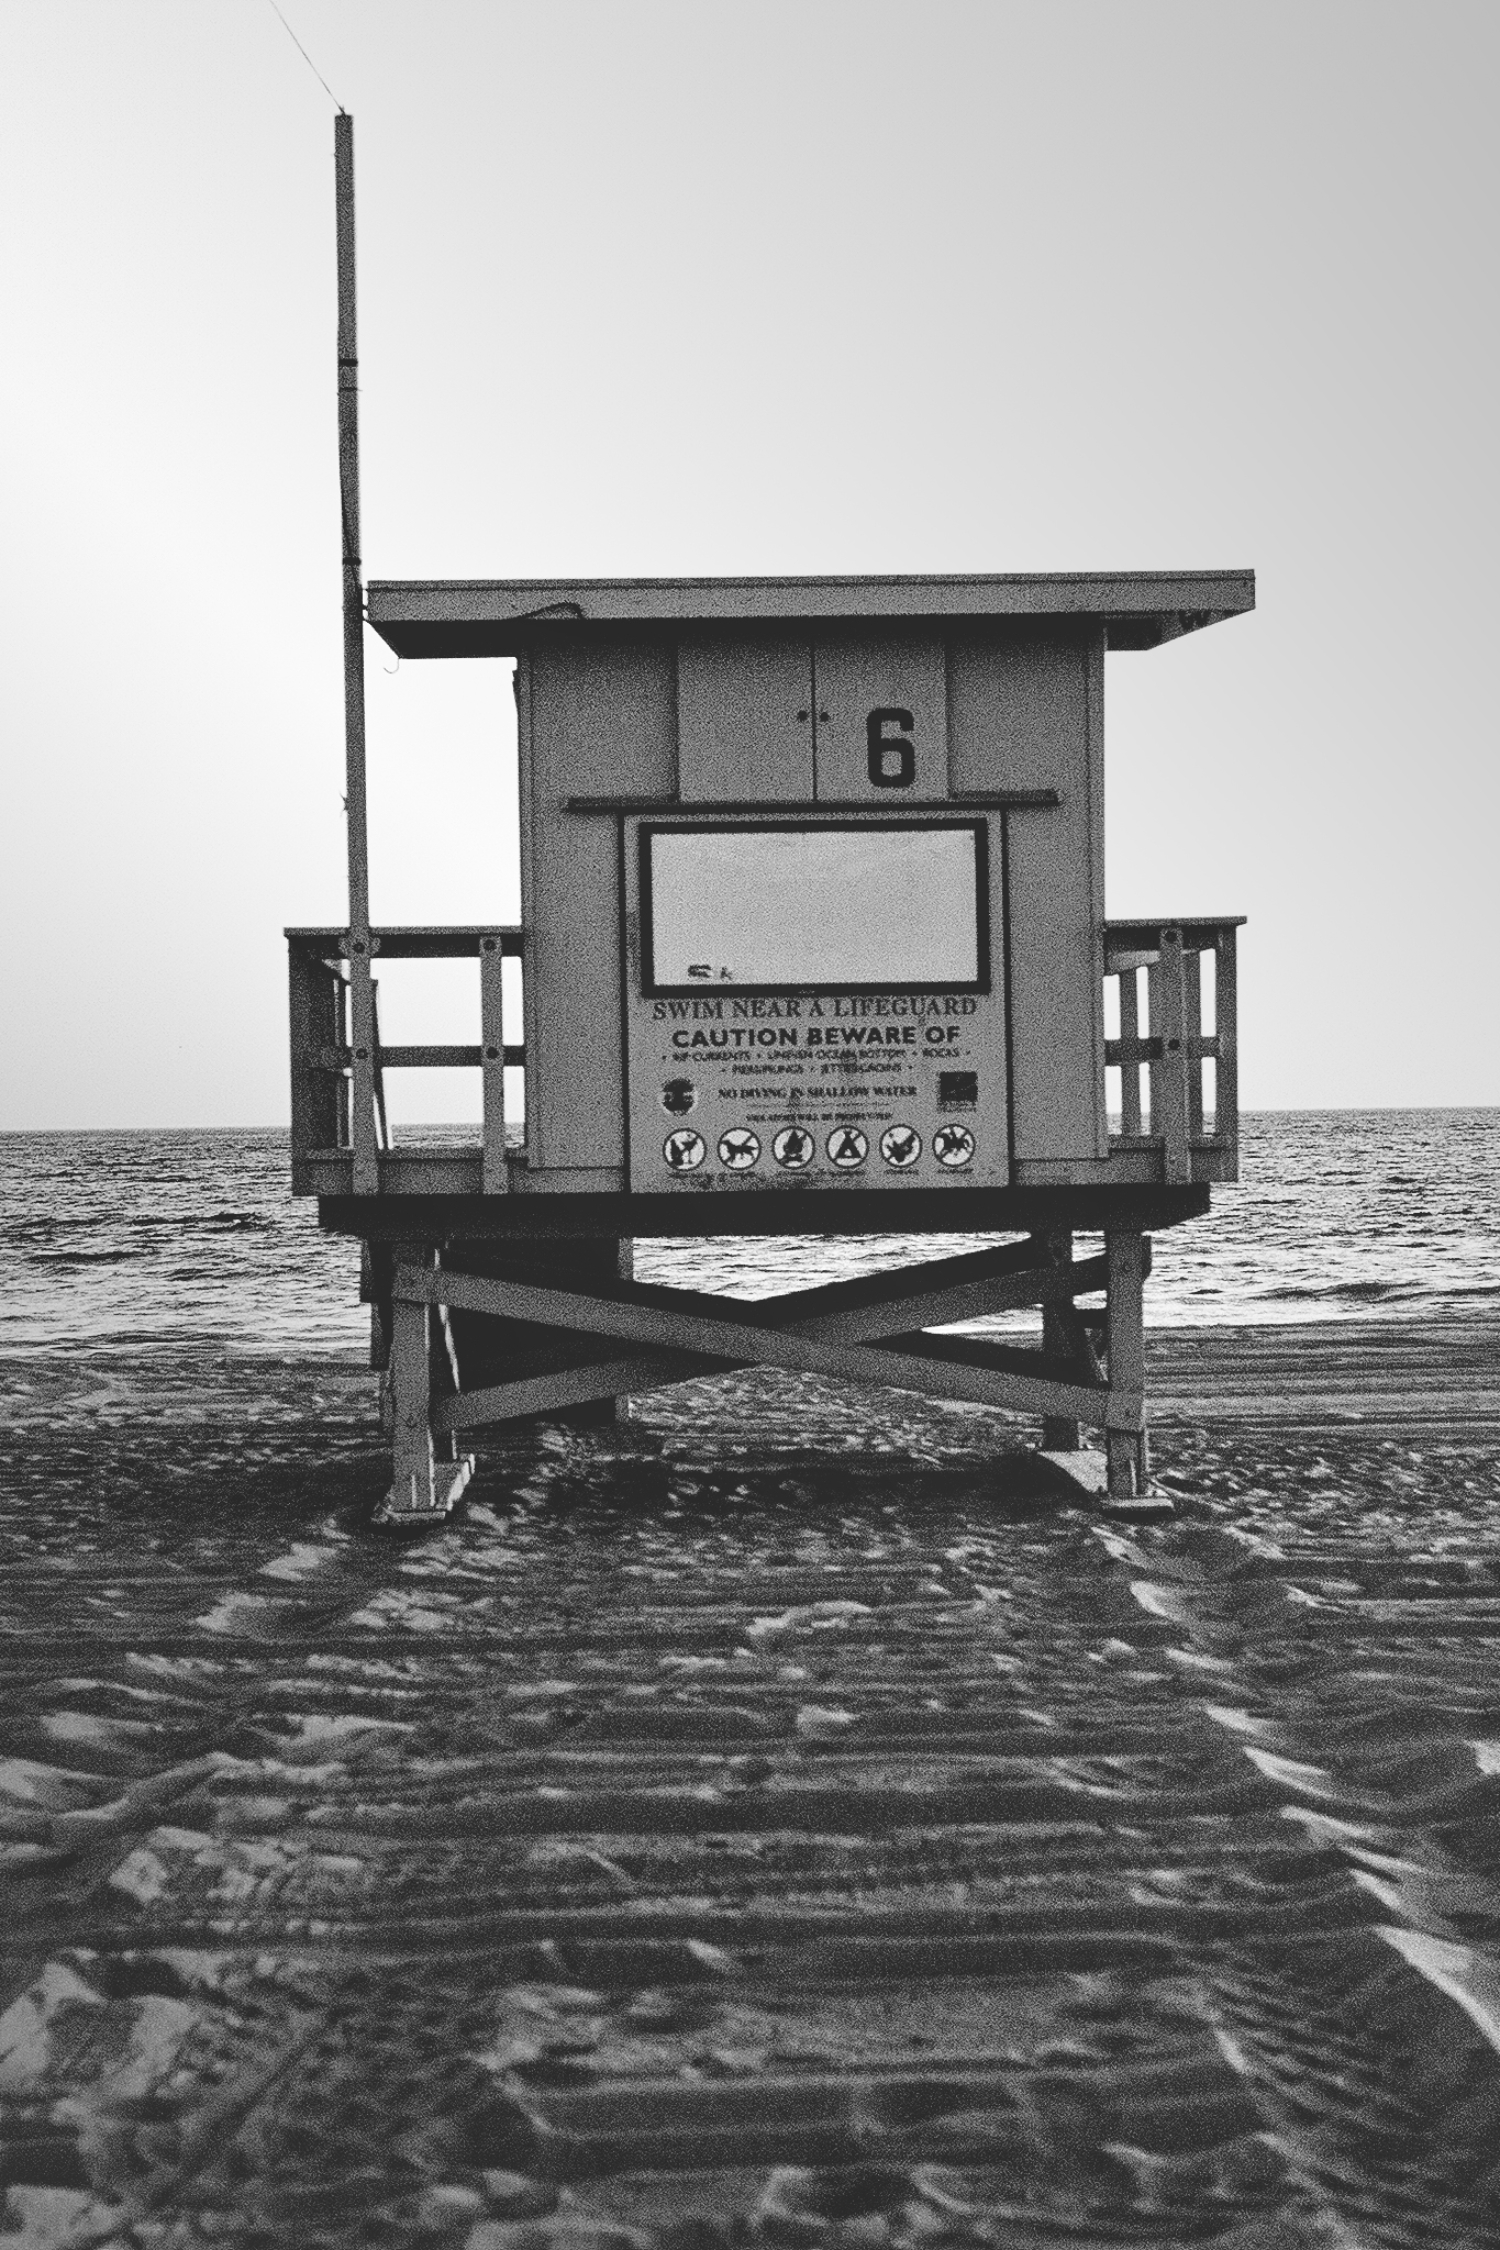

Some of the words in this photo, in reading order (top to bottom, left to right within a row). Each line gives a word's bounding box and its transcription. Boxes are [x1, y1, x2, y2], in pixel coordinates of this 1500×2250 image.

[867, 708, 915, 788] 6
[653, 1001, 723, 1019] SWIM
[733, 1000, 801, 1017] NEAR
[809, 1000, 824, 1016] A
[834, 998, 976, 1016] LIFEGUARD
[672, 1028, 797, 1047] CAUTION
[808, 1026, 916, 1045] BEWARE
[925, 1025, 960, 1044] OF
[692, 1051, 751, 1061] CURRENTS
[923, 1048, 959, 1058] ROCKS
[719, 1088, 738, 1098] NO
[740, 1087, 787, 1098] DIVING
[790, 1087, 804, 1097] IN
[807, 1086, 869, 1097] SHALLOW
[873, 1086, 917, 1096] WATER
